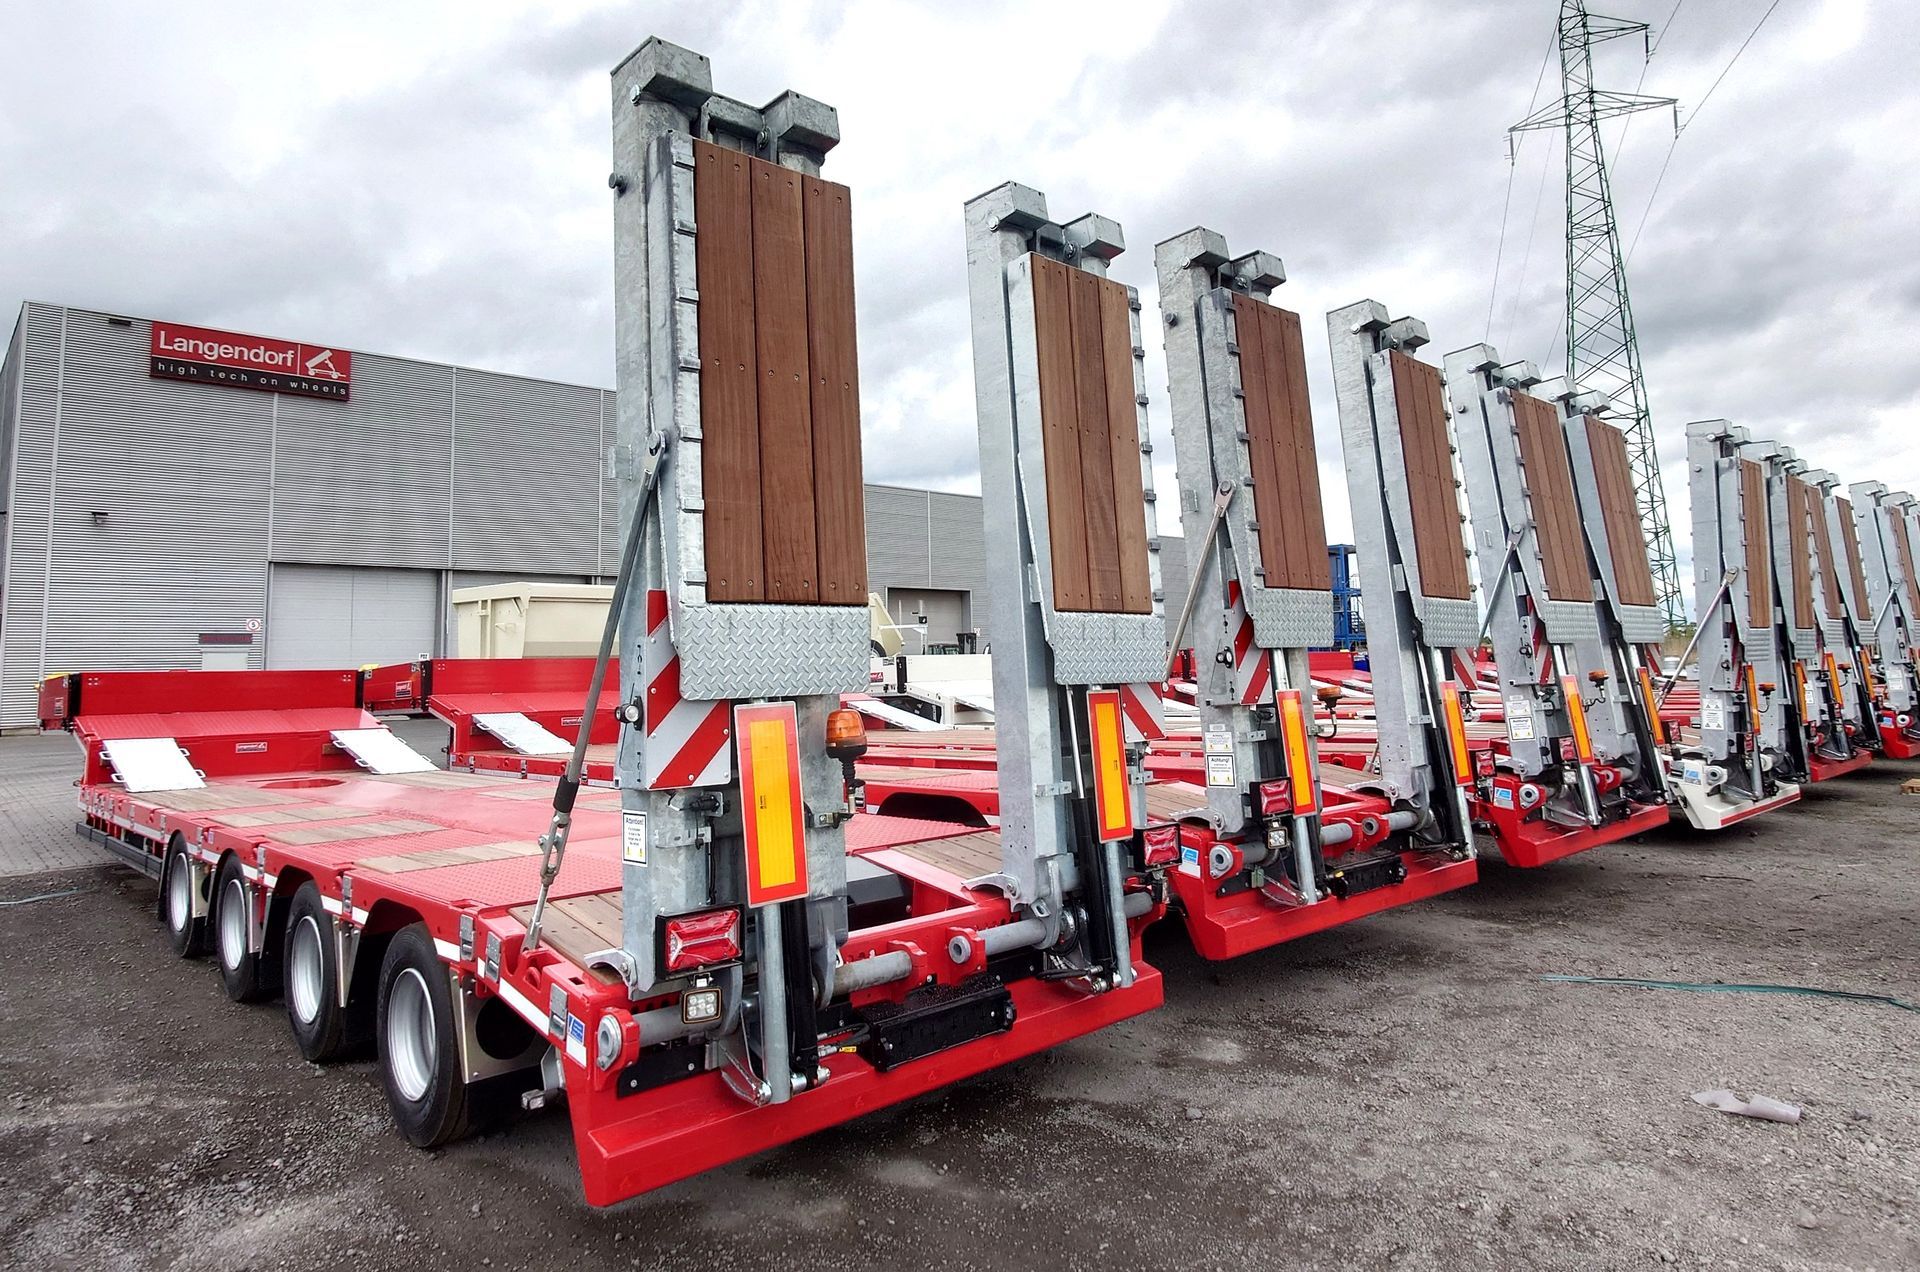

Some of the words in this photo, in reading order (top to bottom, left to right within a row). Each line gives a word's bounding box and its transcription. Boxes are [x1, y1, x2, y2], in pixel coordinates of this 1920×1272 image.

[159, 331, 295, 366] Langendorf
[158, 362, 197, 375] high
[210, 369, 247, 382] tech
[260, 376, 278, 385] on
[290, 381, 346, 395] wheels
